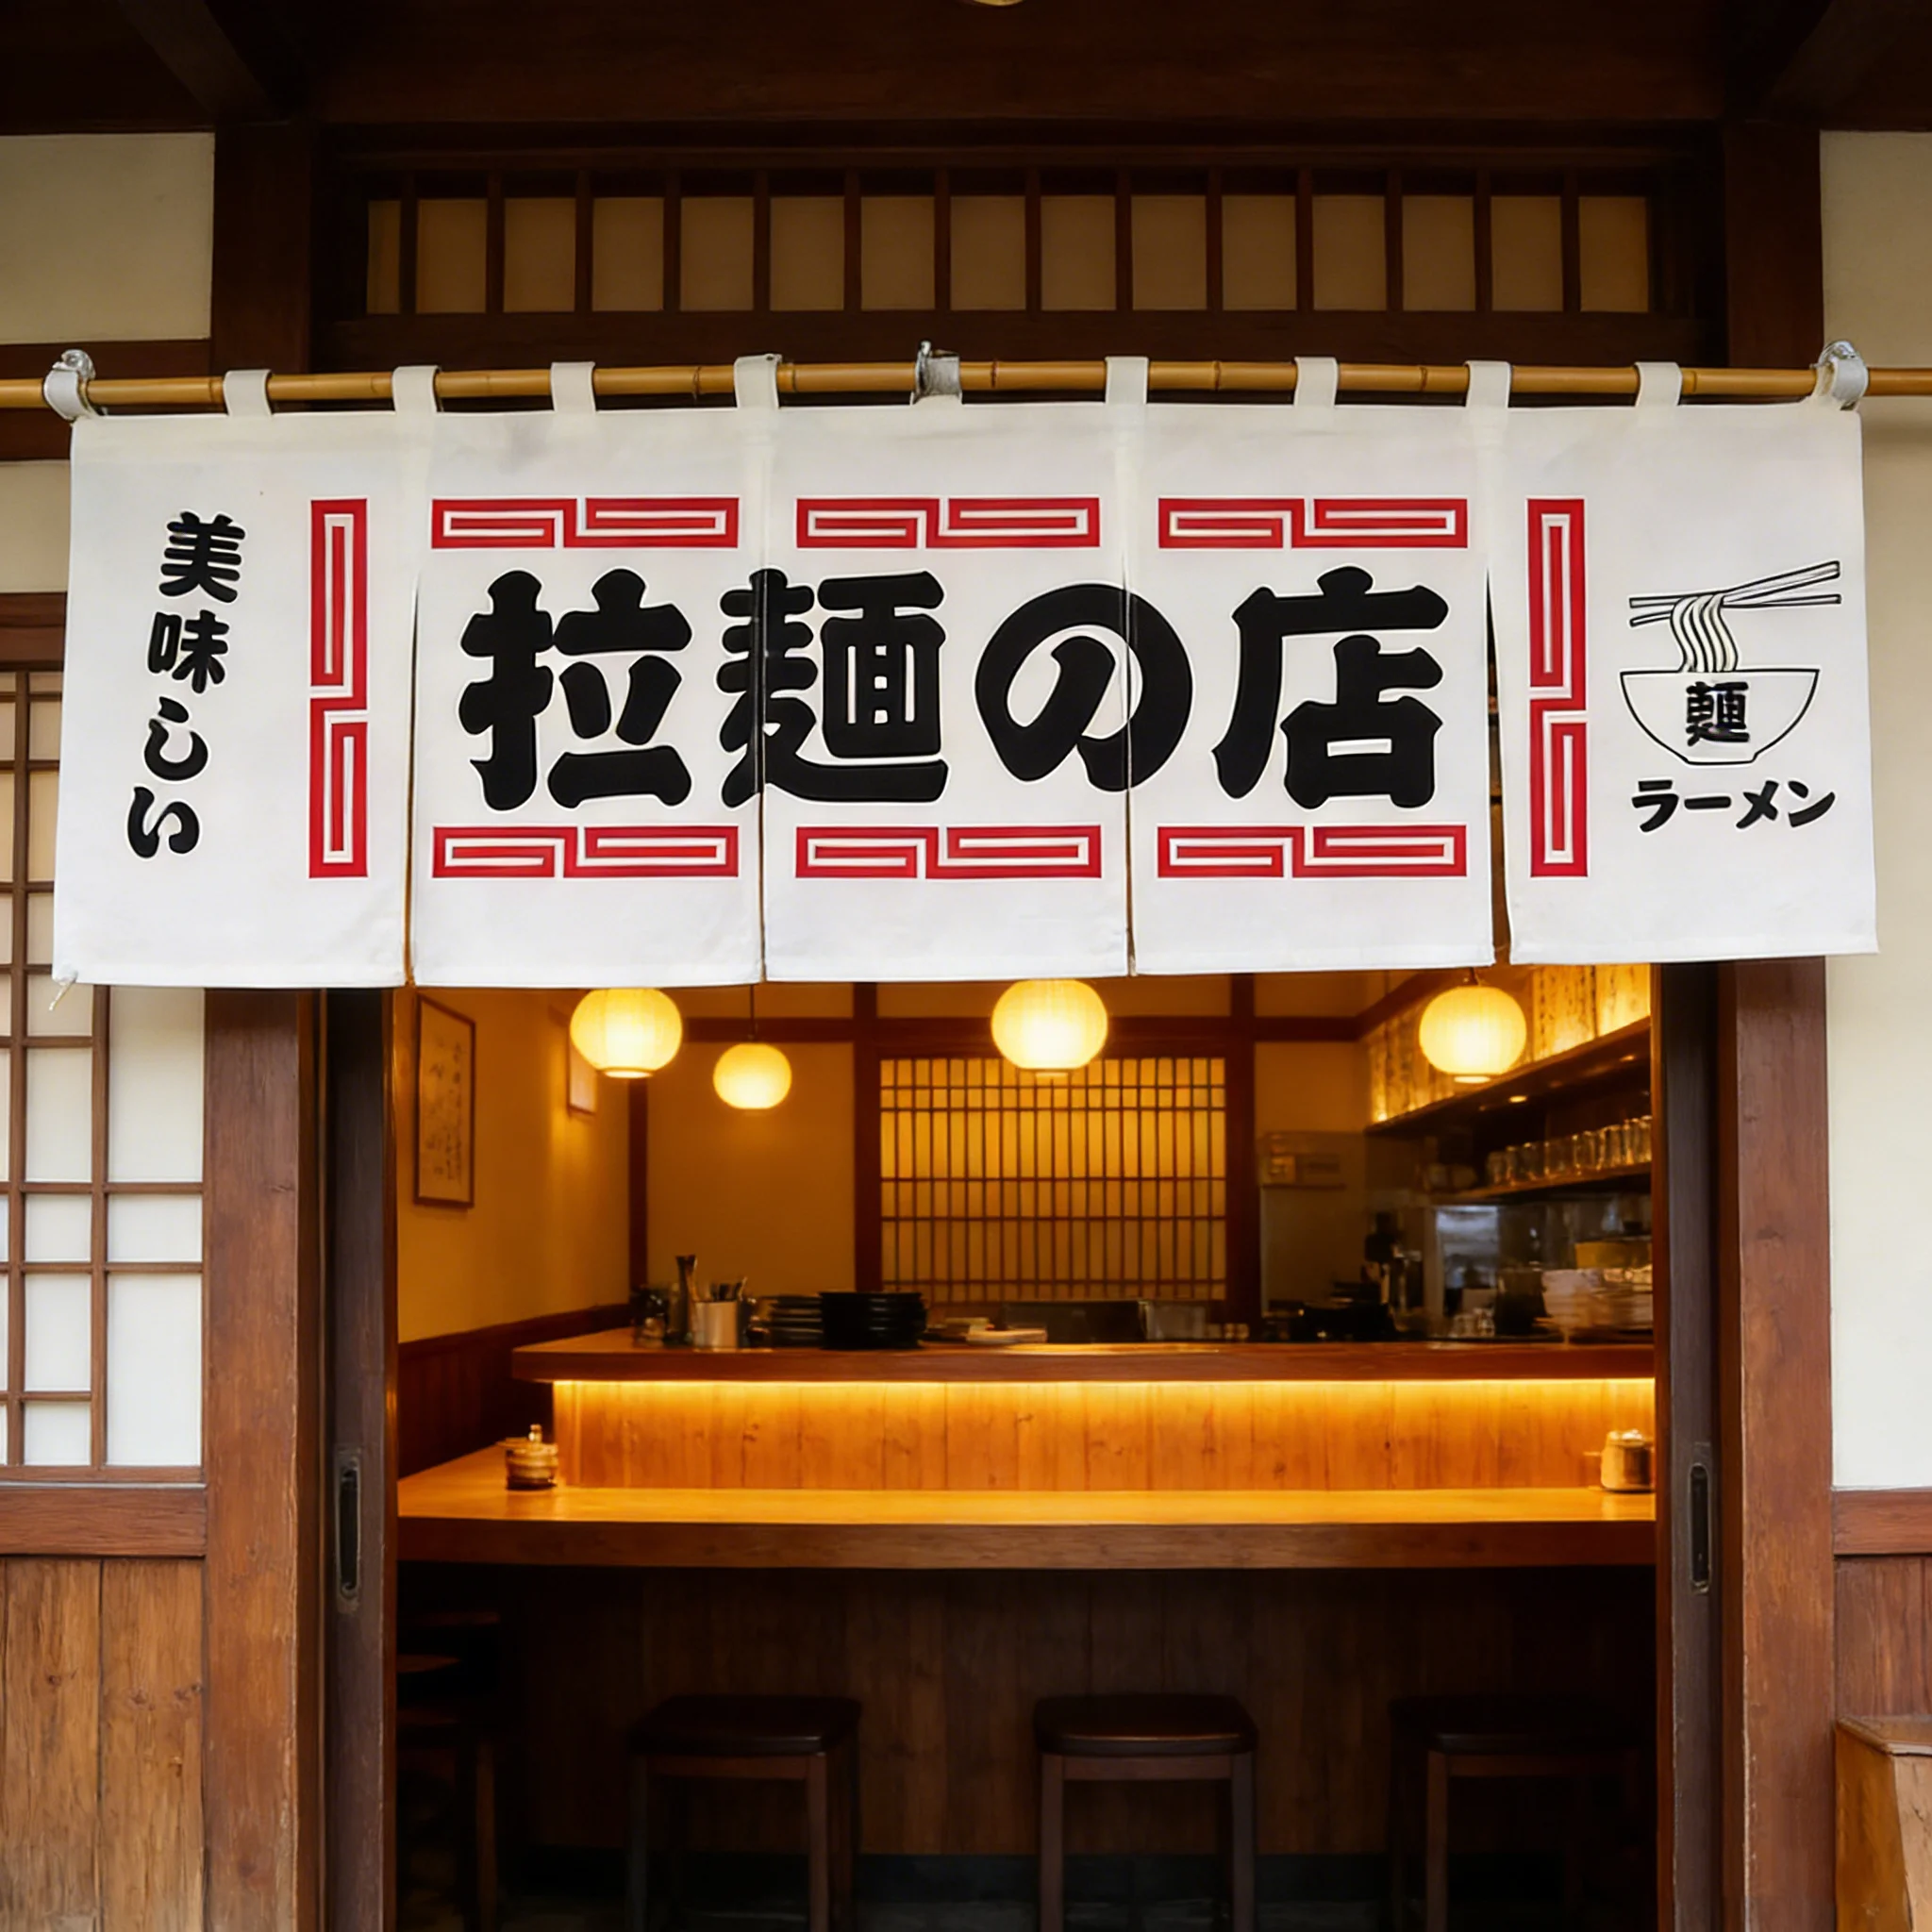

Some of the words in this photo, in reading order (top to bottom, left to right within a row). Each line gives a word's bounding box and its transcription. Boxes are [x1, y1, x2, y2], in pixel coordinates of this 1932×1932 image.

[458, 565, 1449, 810] 拉麺の店
[1631, 779, 1836, 833] ラーメン
